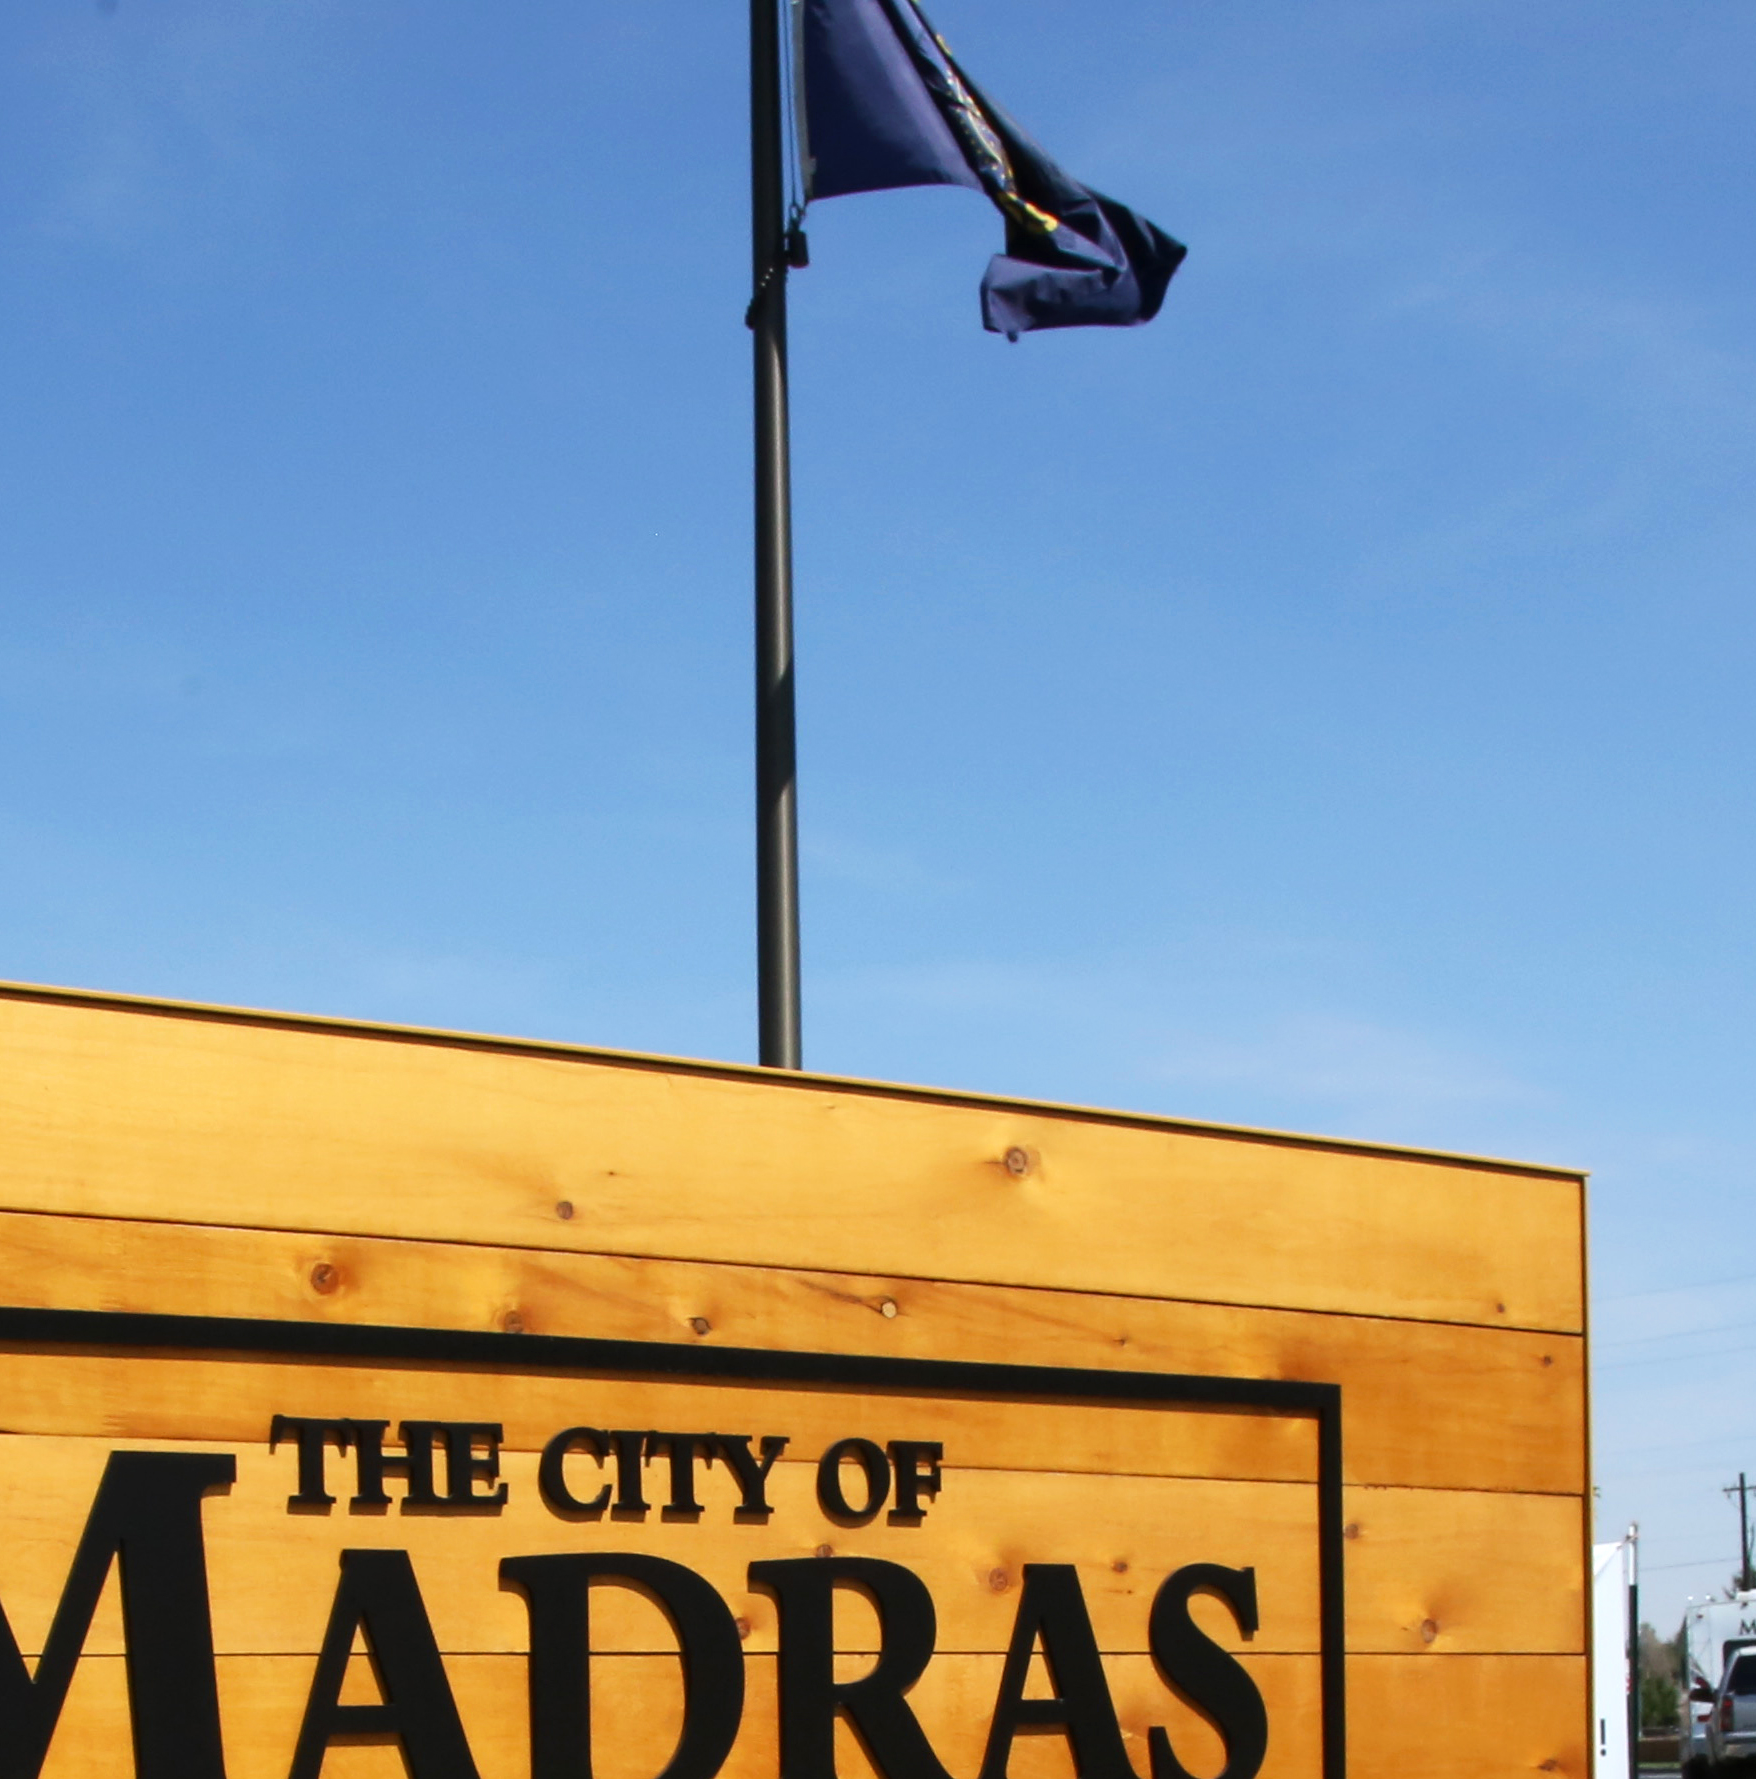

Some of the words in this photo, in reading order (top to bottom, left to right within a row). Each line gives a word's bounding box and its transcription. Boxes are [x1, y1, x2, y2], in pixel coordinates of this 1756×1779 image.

[269, 1414, 509, 1510] THE
[539, 1426, 791, 1520] CITY
[817, 1437, 945, 1524] OF
